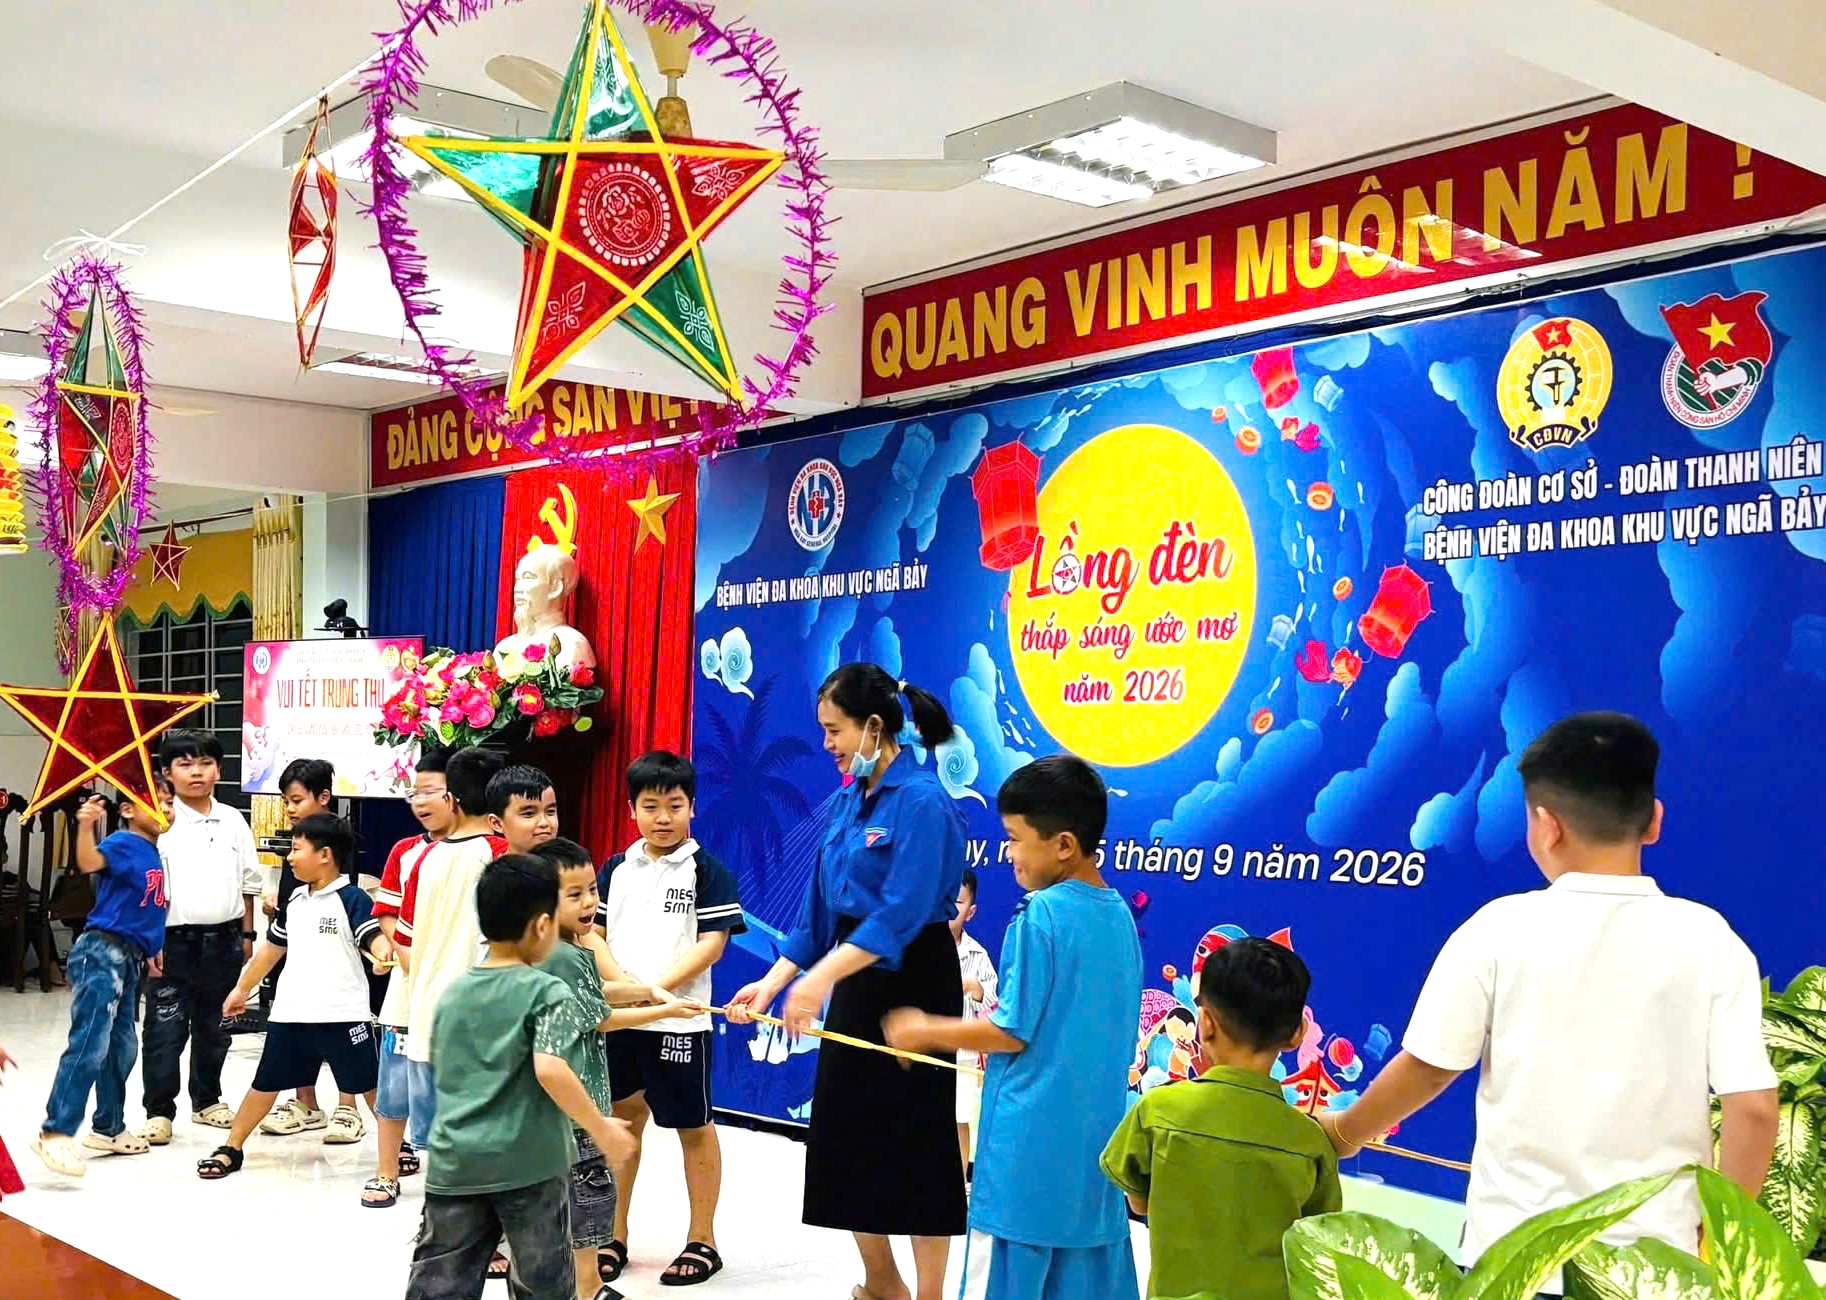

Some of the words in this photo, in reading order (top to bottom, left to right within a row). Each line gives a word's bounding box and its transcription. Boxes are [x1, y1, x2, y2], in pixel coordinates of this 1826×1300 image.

[871, 277, 1046, 378] QUANG
[1064, 235, 1212, 337] VINH
[1235, 175, 1454, 302] MUÔN
[1483, 123, 1688, 249] NĂM
[387, 406, 458, 470] ĐẢNG
[1423, 479, 1473, 516] CÔNG
[1479, 470, 1531, 507] ĐOÀN
[1538, 473, 1566, 503] CƠ
[1571, 458, 1599, 499] SỞ
[1619, 457, 1678, 495] ĐOÀN
[1686, 451, 1760, 489] THANH
[1767, 437, 1822, 477] NIÊN
[1424, 529, 1472, 564] BỆNH
[1477, 519, 1521, 562] VIỆN
[1527, 523, 1555, 552] ĐA
[1561, 515, 1615, 549] KHOA
[1622, 511, 1664, 544] KHU
[1672, 505, 1719, 546] VỰC
[1725, 494, 1773, 534] NGÃ
[1781, 485, 1826, 529] BẢY
[716, 580, 743, 611] BỆNH
[746, 577, 769, 608] VIỆN
[772, 580, 787, 602] ĐA
[790, 575, 819, 600] KHOA
[822, 573, 845, 597] KHU
[848, 568, 873, 599] VỰC
[876, 563, 900, 592] NGÃ
[904, 558, 928, 589] BẢY
[1026, 520, 1140, 614] Lồng
[1149, 521, 1233, 585] đèn
[1021, 612, 1070, 660] thắp
[1079, 616, 1134, 659] sáng
[1145, 611, 1186, 644] ước
[1196, 611, 1238, 640] mơ
[277, 679, 294, 708] VUI
[299, 668, 316, 708] TẾT
[322, 678, 359, 709] TRUNG
[364, 678, 385, 708] THU
[1064, 674, 1112, 702] năm
[1123, 669, 1185, 702] 2026
[1114, 839, 1203, 881] tháng
[1213, 843, 1234, 876] 9
[1242, 843, 1320, 881] năm
[1330, 848, 1426, 887] 2026
[659, 1048, 692, 1063] SMG
[662, 1034, 692, 1049] MES
